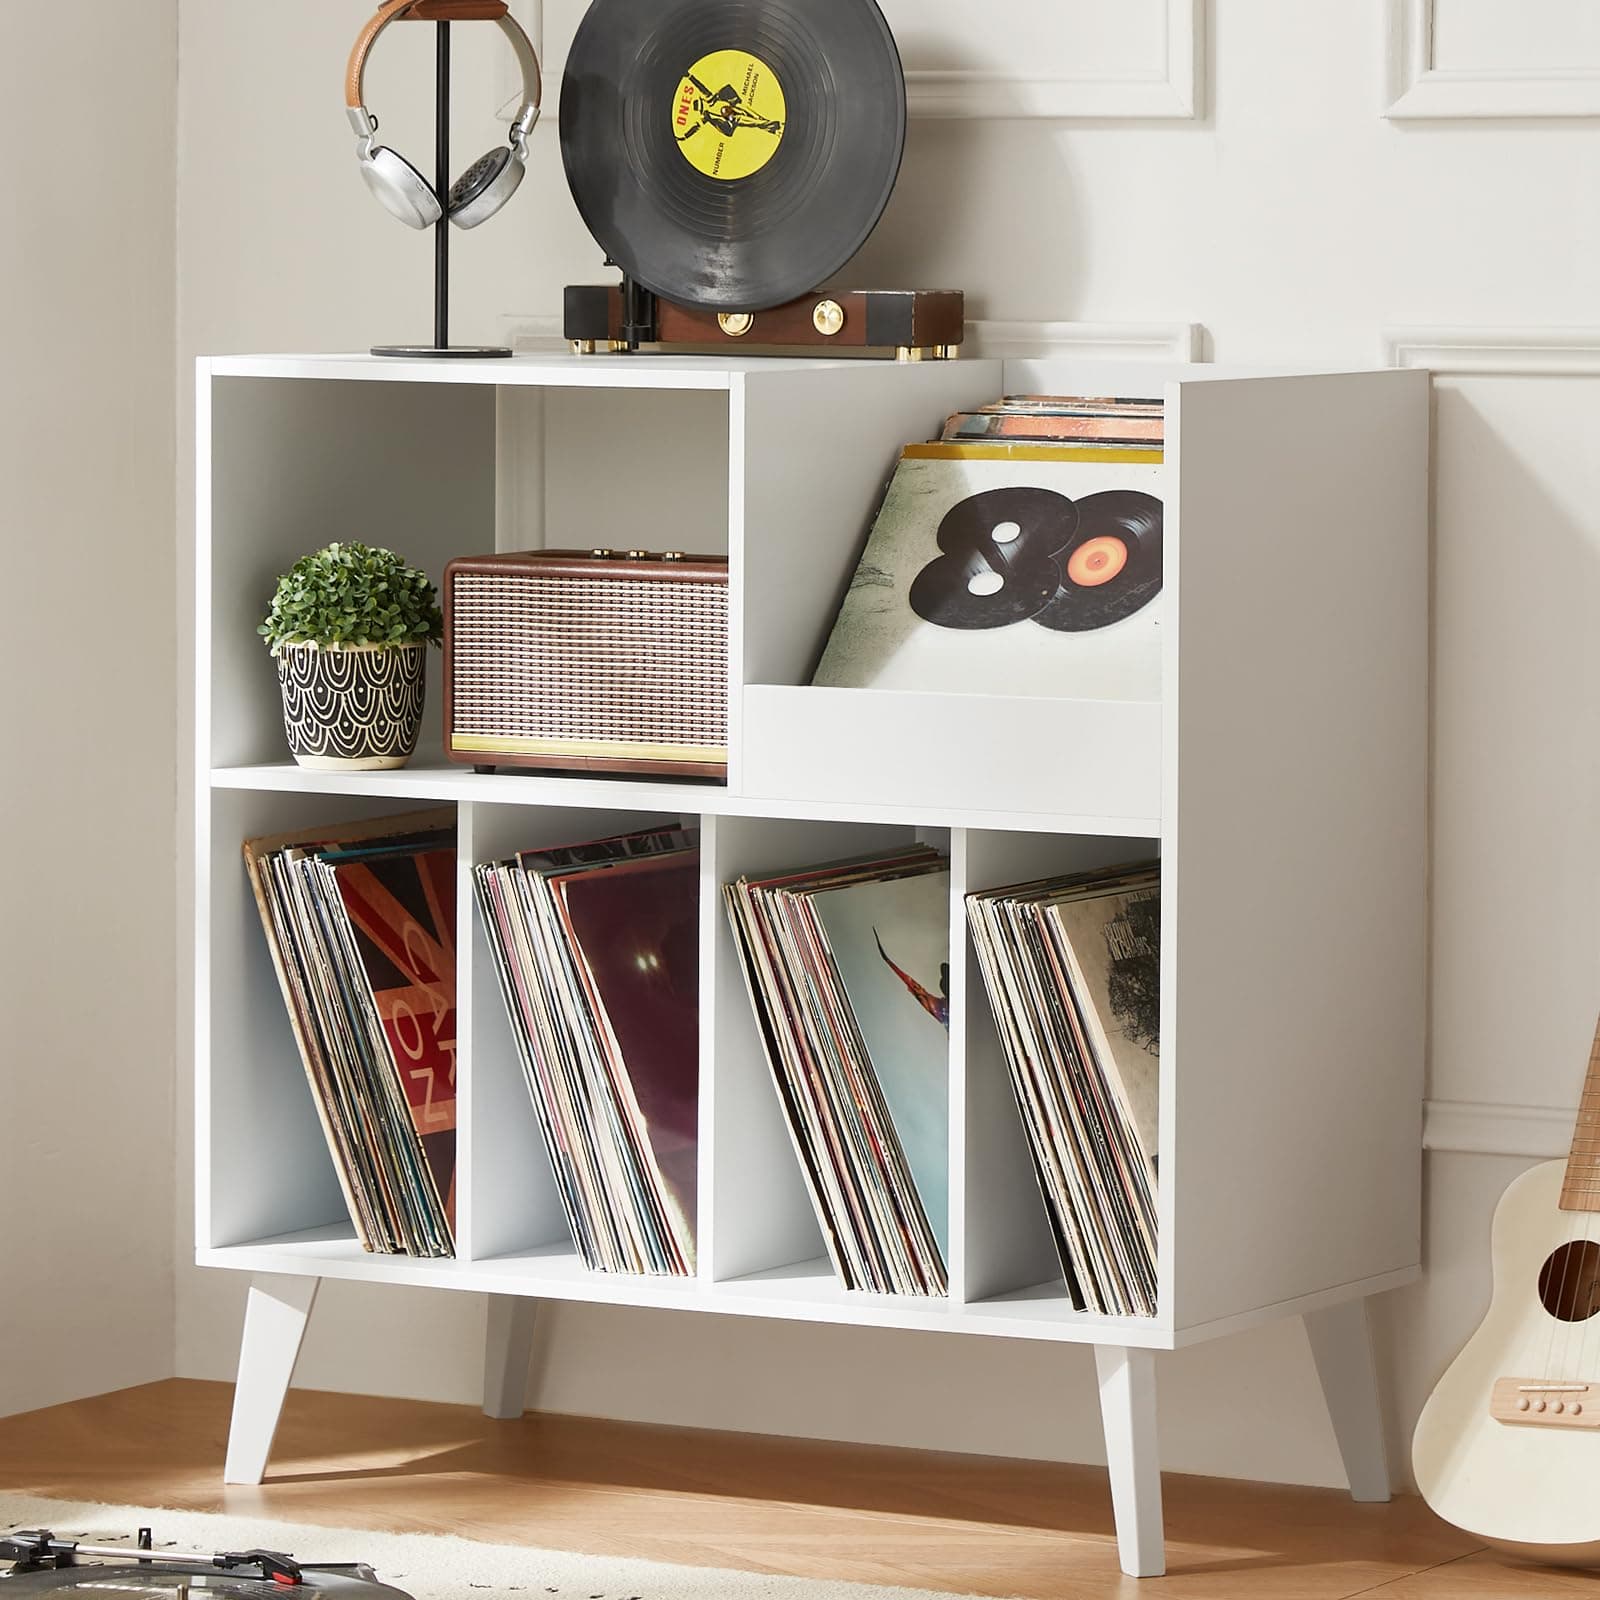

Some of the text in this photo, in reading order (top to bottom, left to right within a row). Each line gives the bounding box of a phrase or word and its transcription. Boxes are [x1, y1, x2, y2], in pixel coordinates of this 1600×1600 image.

[742, 63, 755, 96] MICHAEL
[748, 73, 760, 106] JACKSON
[677, 85, 695, 126] ONES
[712, 142, 725, 176] NUMBER
[392, 998, 449, 1124] ON
